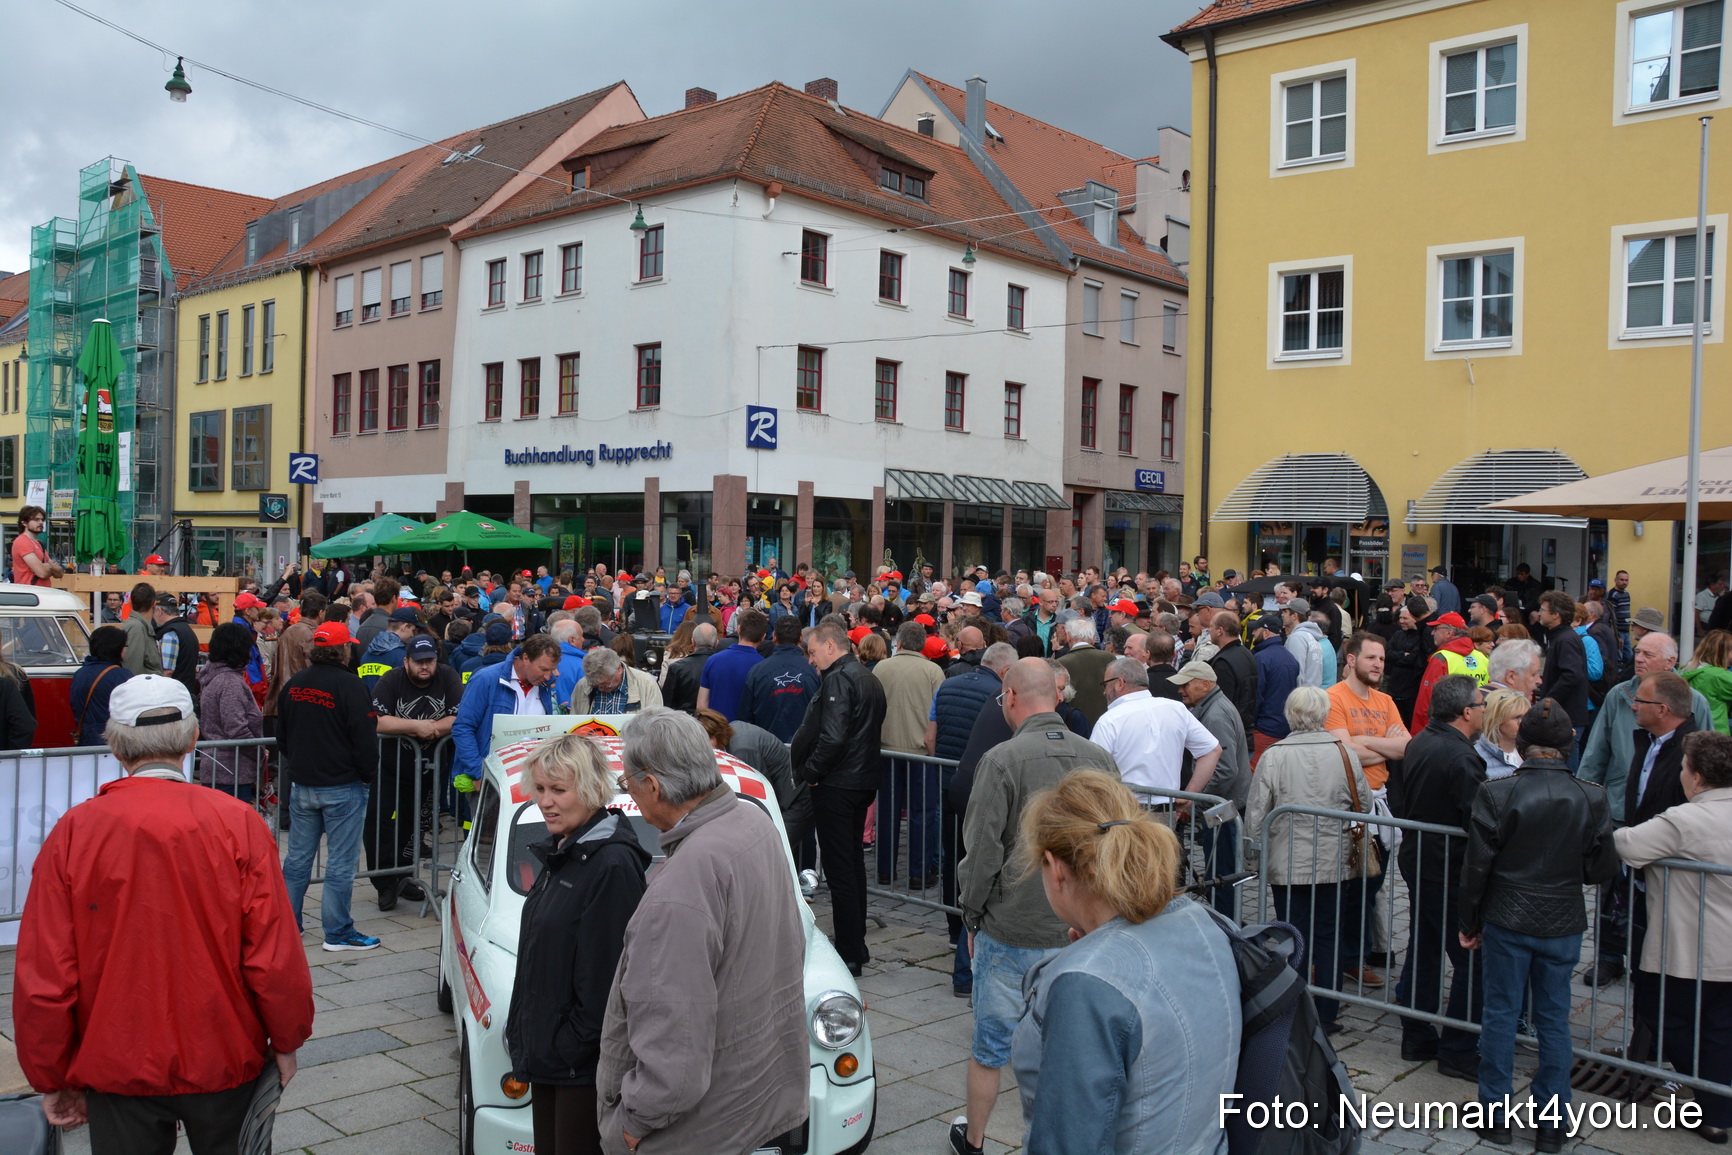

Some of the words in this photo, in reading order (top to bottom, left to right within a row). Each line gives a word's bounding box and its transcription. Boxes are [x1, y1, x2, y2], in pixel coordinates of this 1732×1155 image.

[505, 445, 594, 466] Buchhandlung
[599, 440, 672, 464] Rupprecht
[1140, 471, 1163, 484] CECIL
[362, 665, 382, 674] THW
